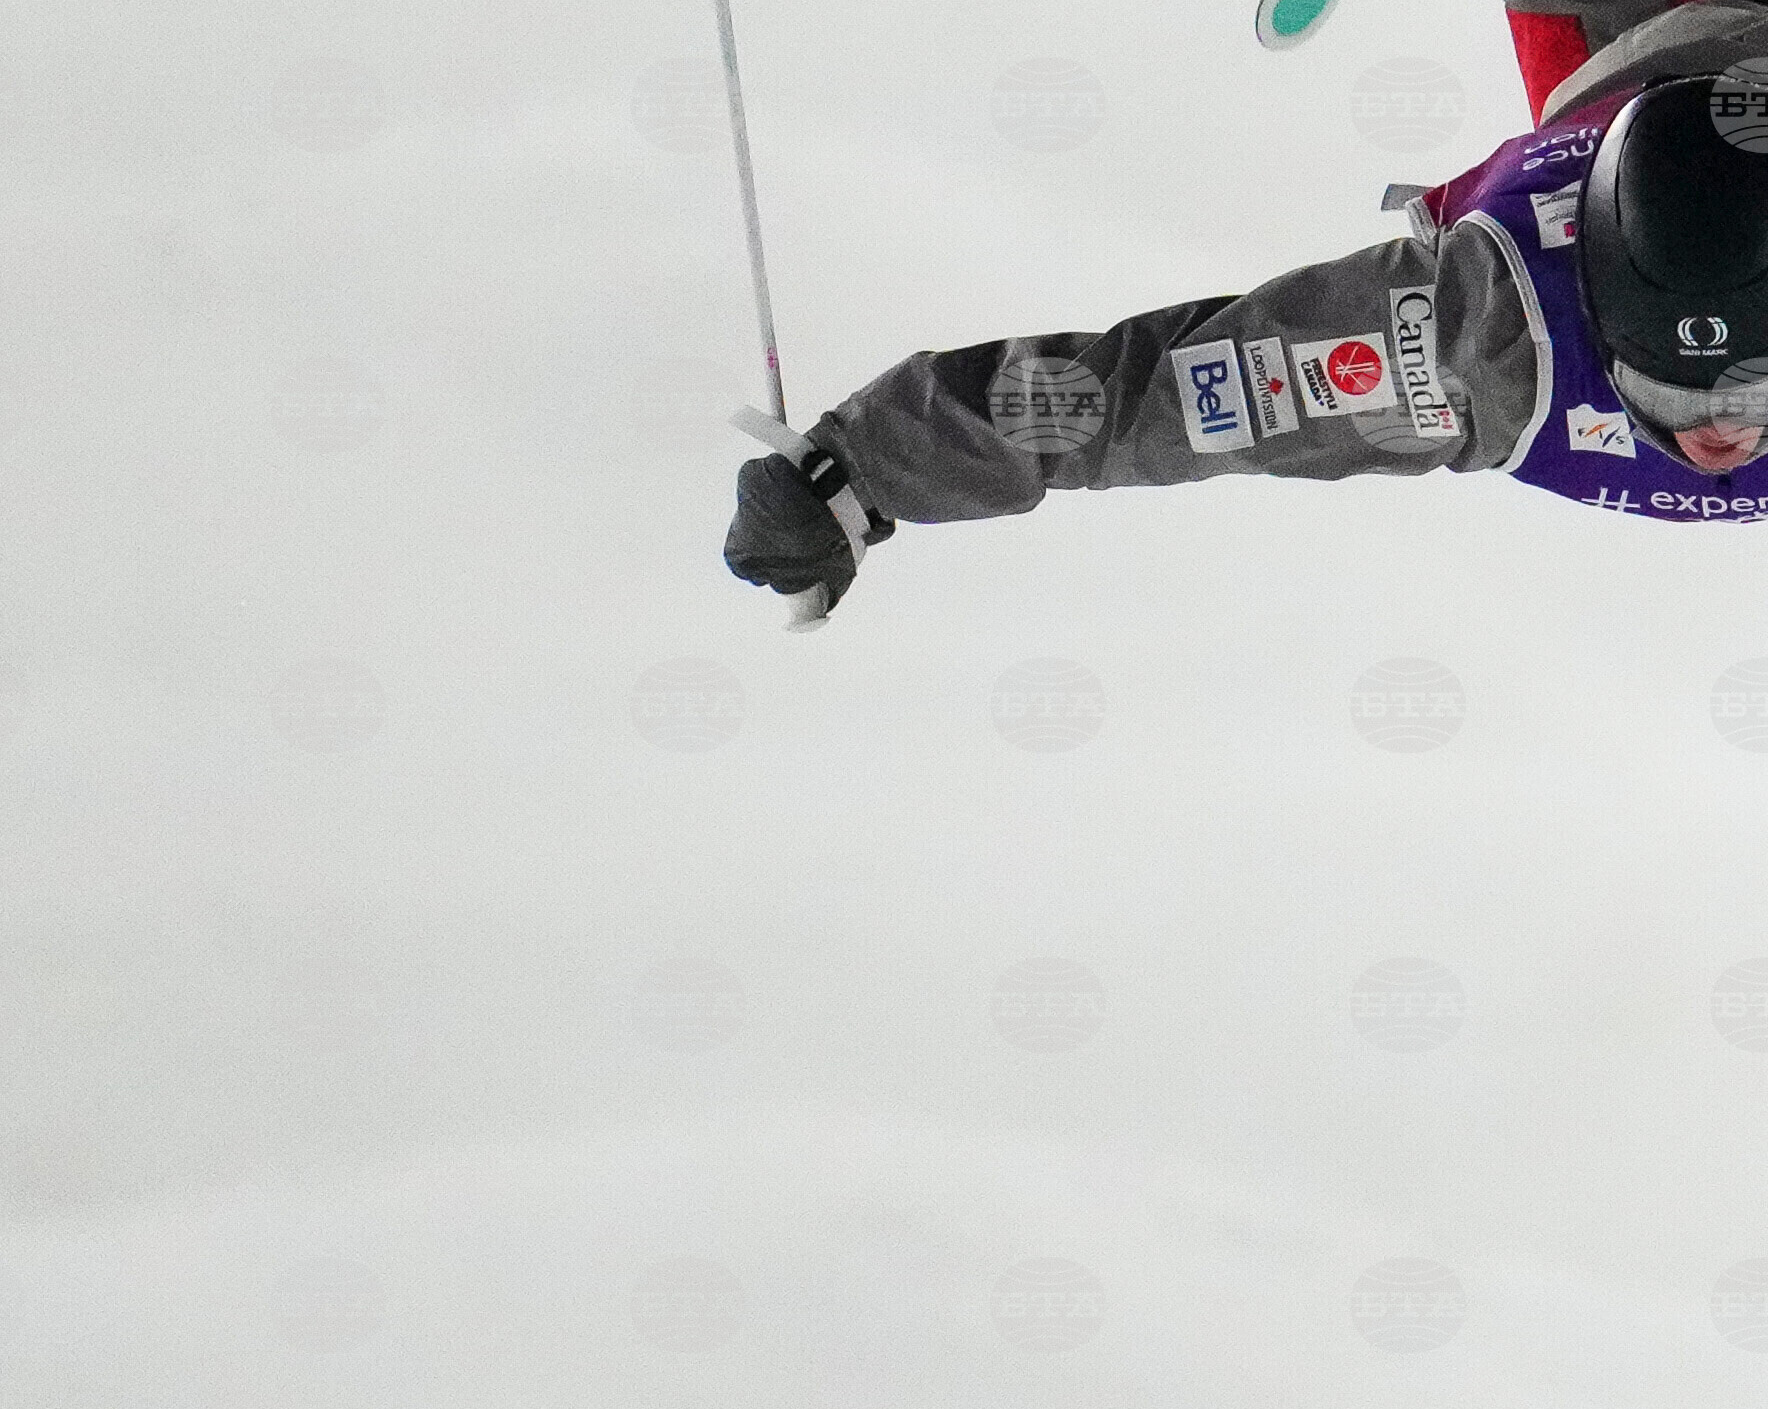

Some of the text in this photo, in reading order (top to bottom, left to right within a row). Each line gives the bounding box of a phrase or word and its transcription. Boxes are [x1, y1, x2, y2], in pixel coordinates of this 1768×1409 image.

[1190, 359, 1239, 434] Bell
[1310, 357, 1338, 410] FREESTYLE
[1396, 292, 1448, 430] Canada
